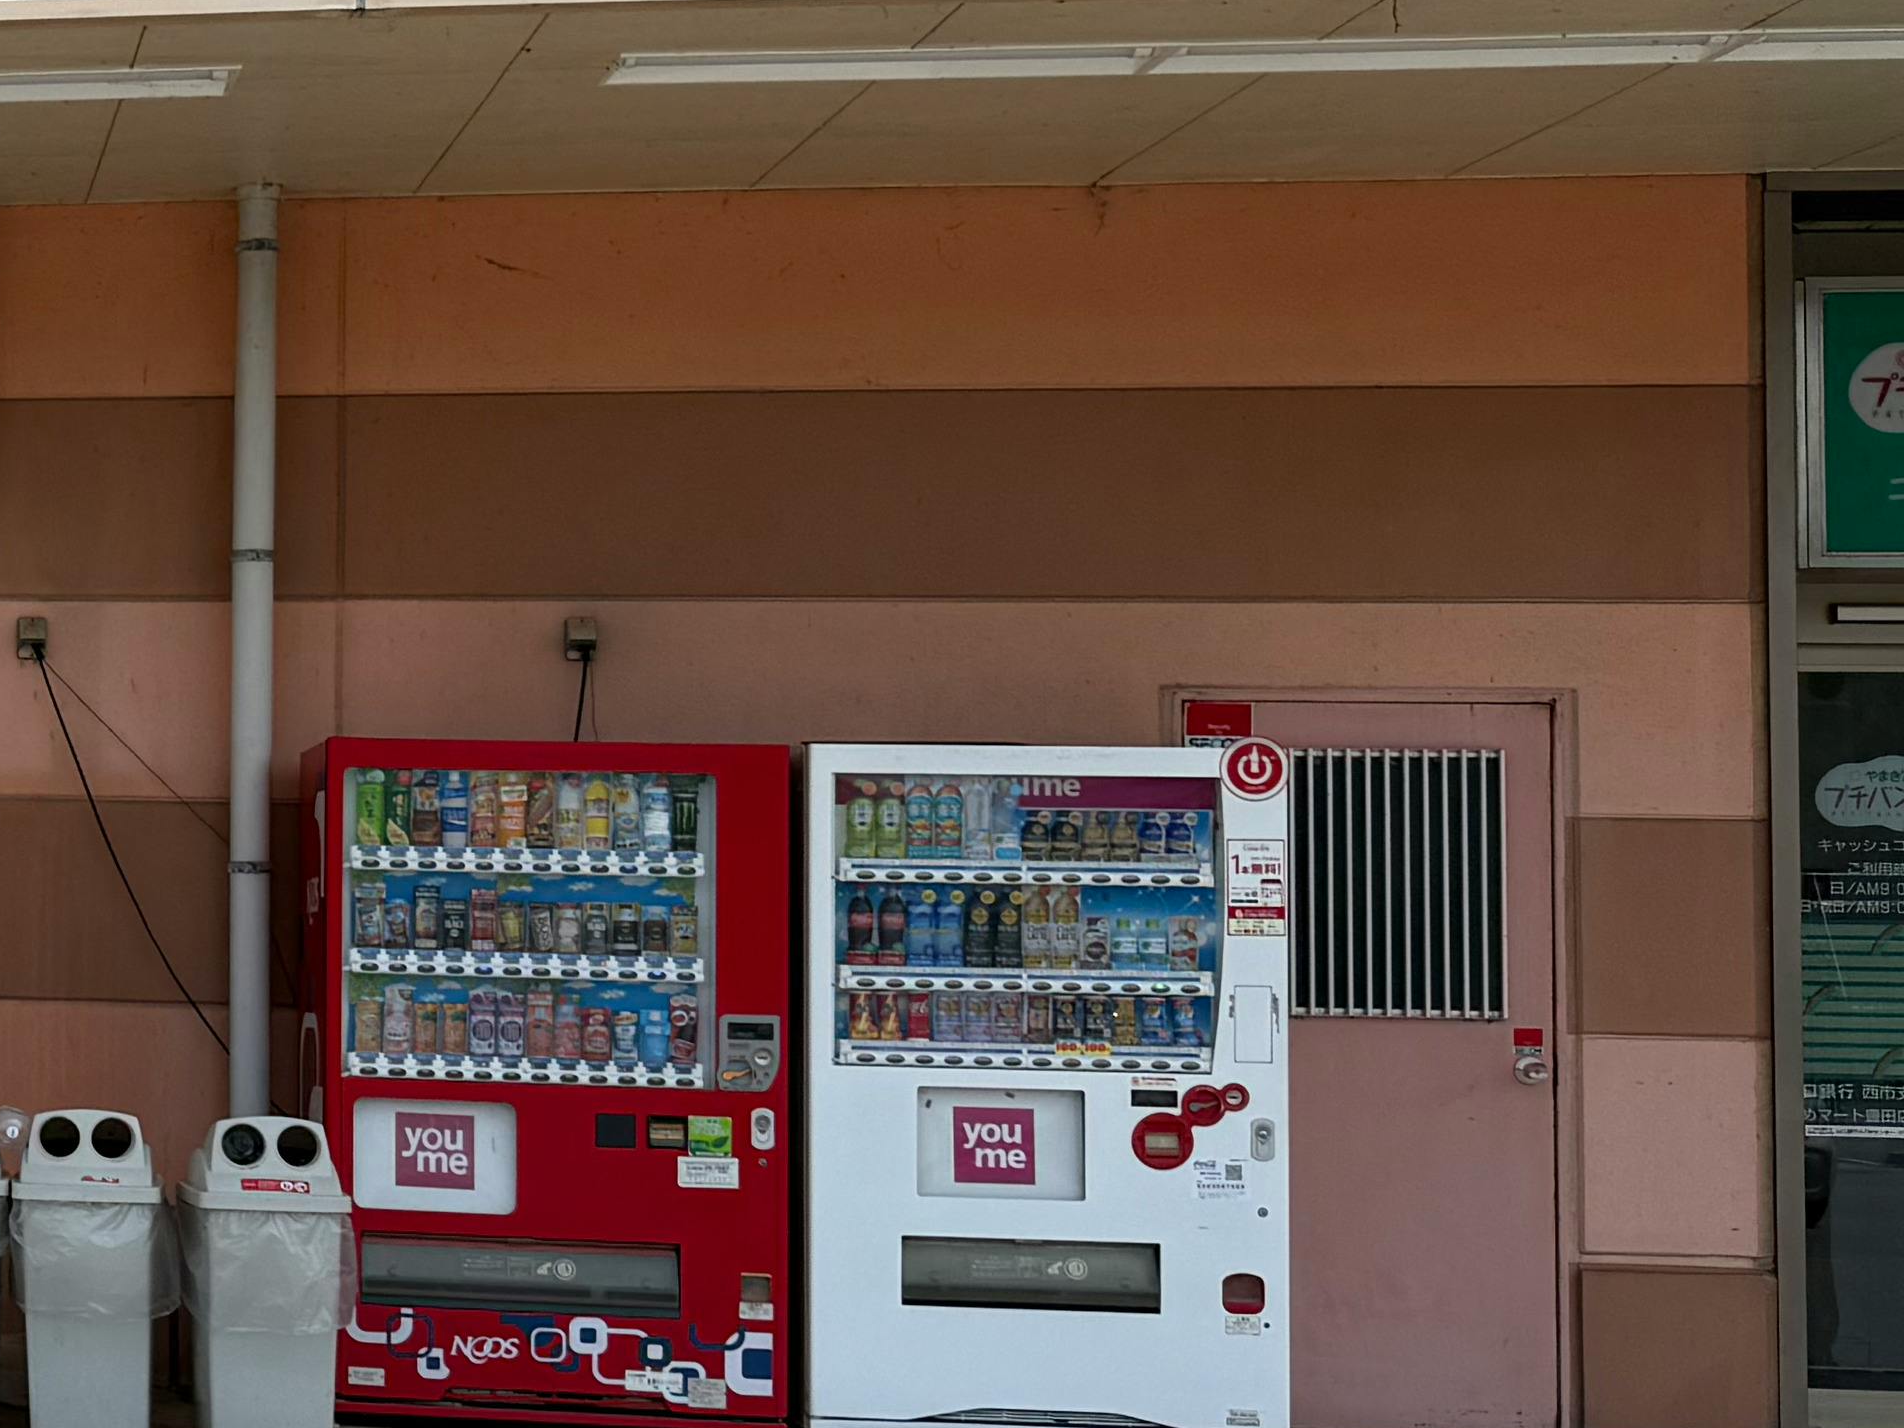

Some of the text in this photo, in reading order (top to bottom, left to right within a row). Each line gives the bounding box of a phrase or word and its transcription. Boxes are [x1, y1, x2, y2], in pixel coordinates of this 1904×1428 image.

[402, 1124, 464, 1157] you
[962, 1120, 1023, 1149] you
[416, 1149, 469, 1176] me
[974, 1145, 1028, 1170] me
